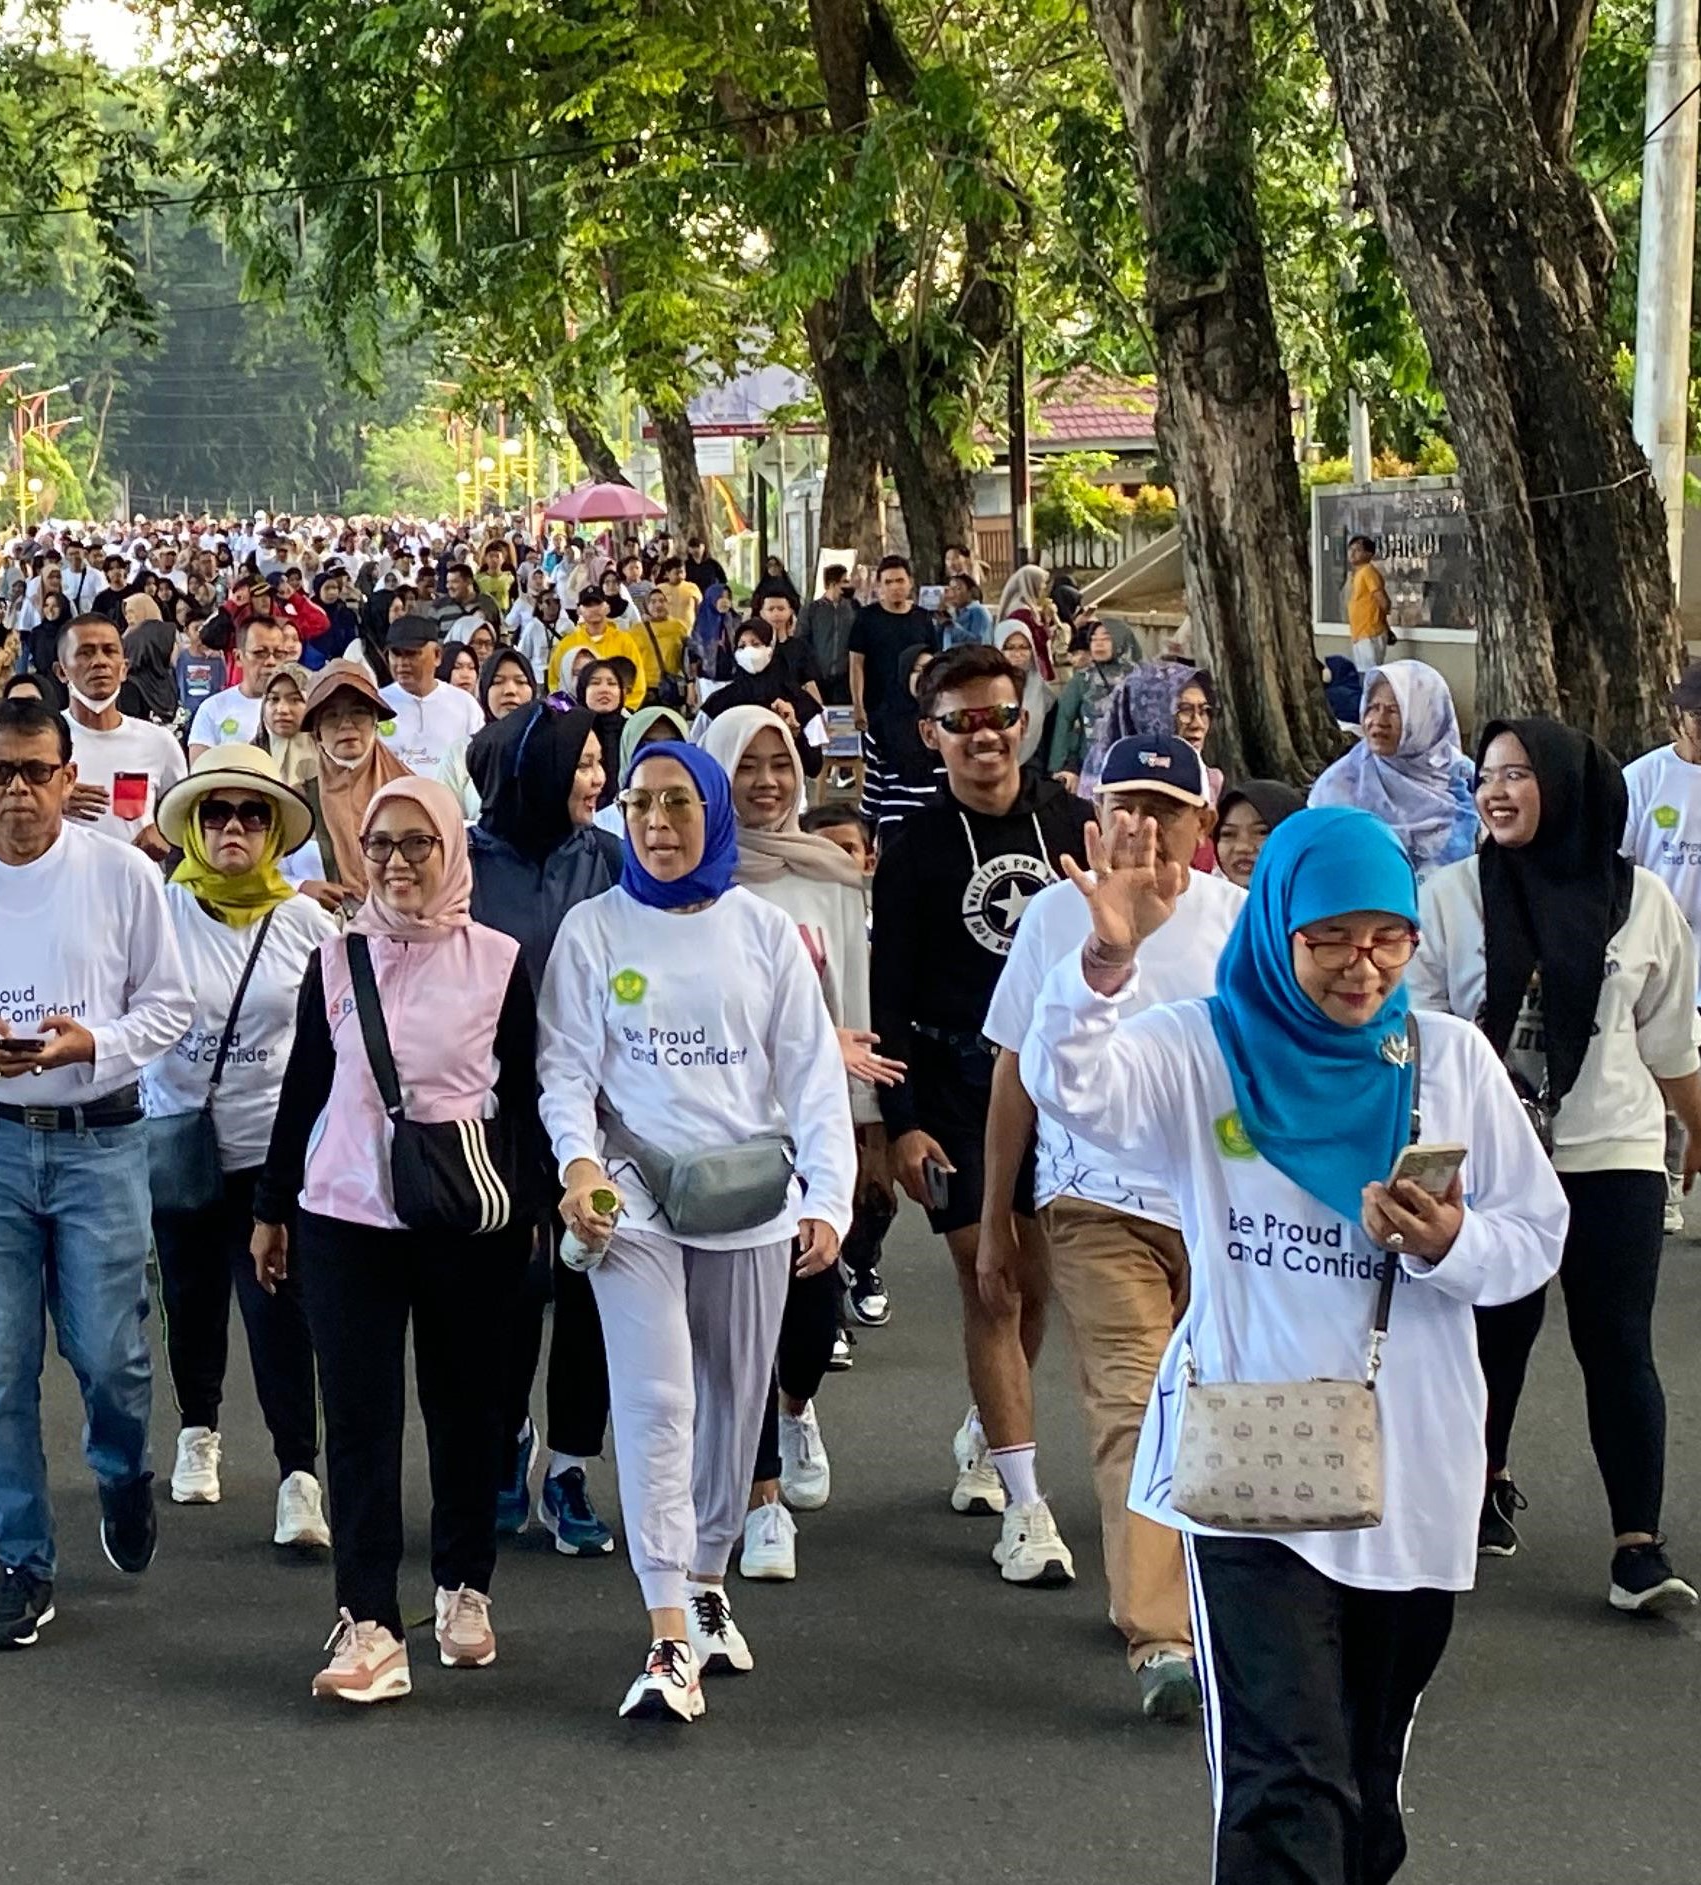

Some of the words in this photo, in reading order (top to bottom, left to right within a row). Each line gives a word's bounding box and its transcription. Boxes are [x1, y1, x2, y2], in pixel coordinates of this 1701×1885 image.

[967, 861, 1007, 908] WAITING
[1014, 859, 1037, 871] FOR
[197, 1032, 241, 1048] Prod
[623, 1026, 644, 1044] Be
[649, 1026, 706, 1045] Proud
[631, 1047, 658, 1066] and
[1264, 1213, 1342, 1248] Proud
